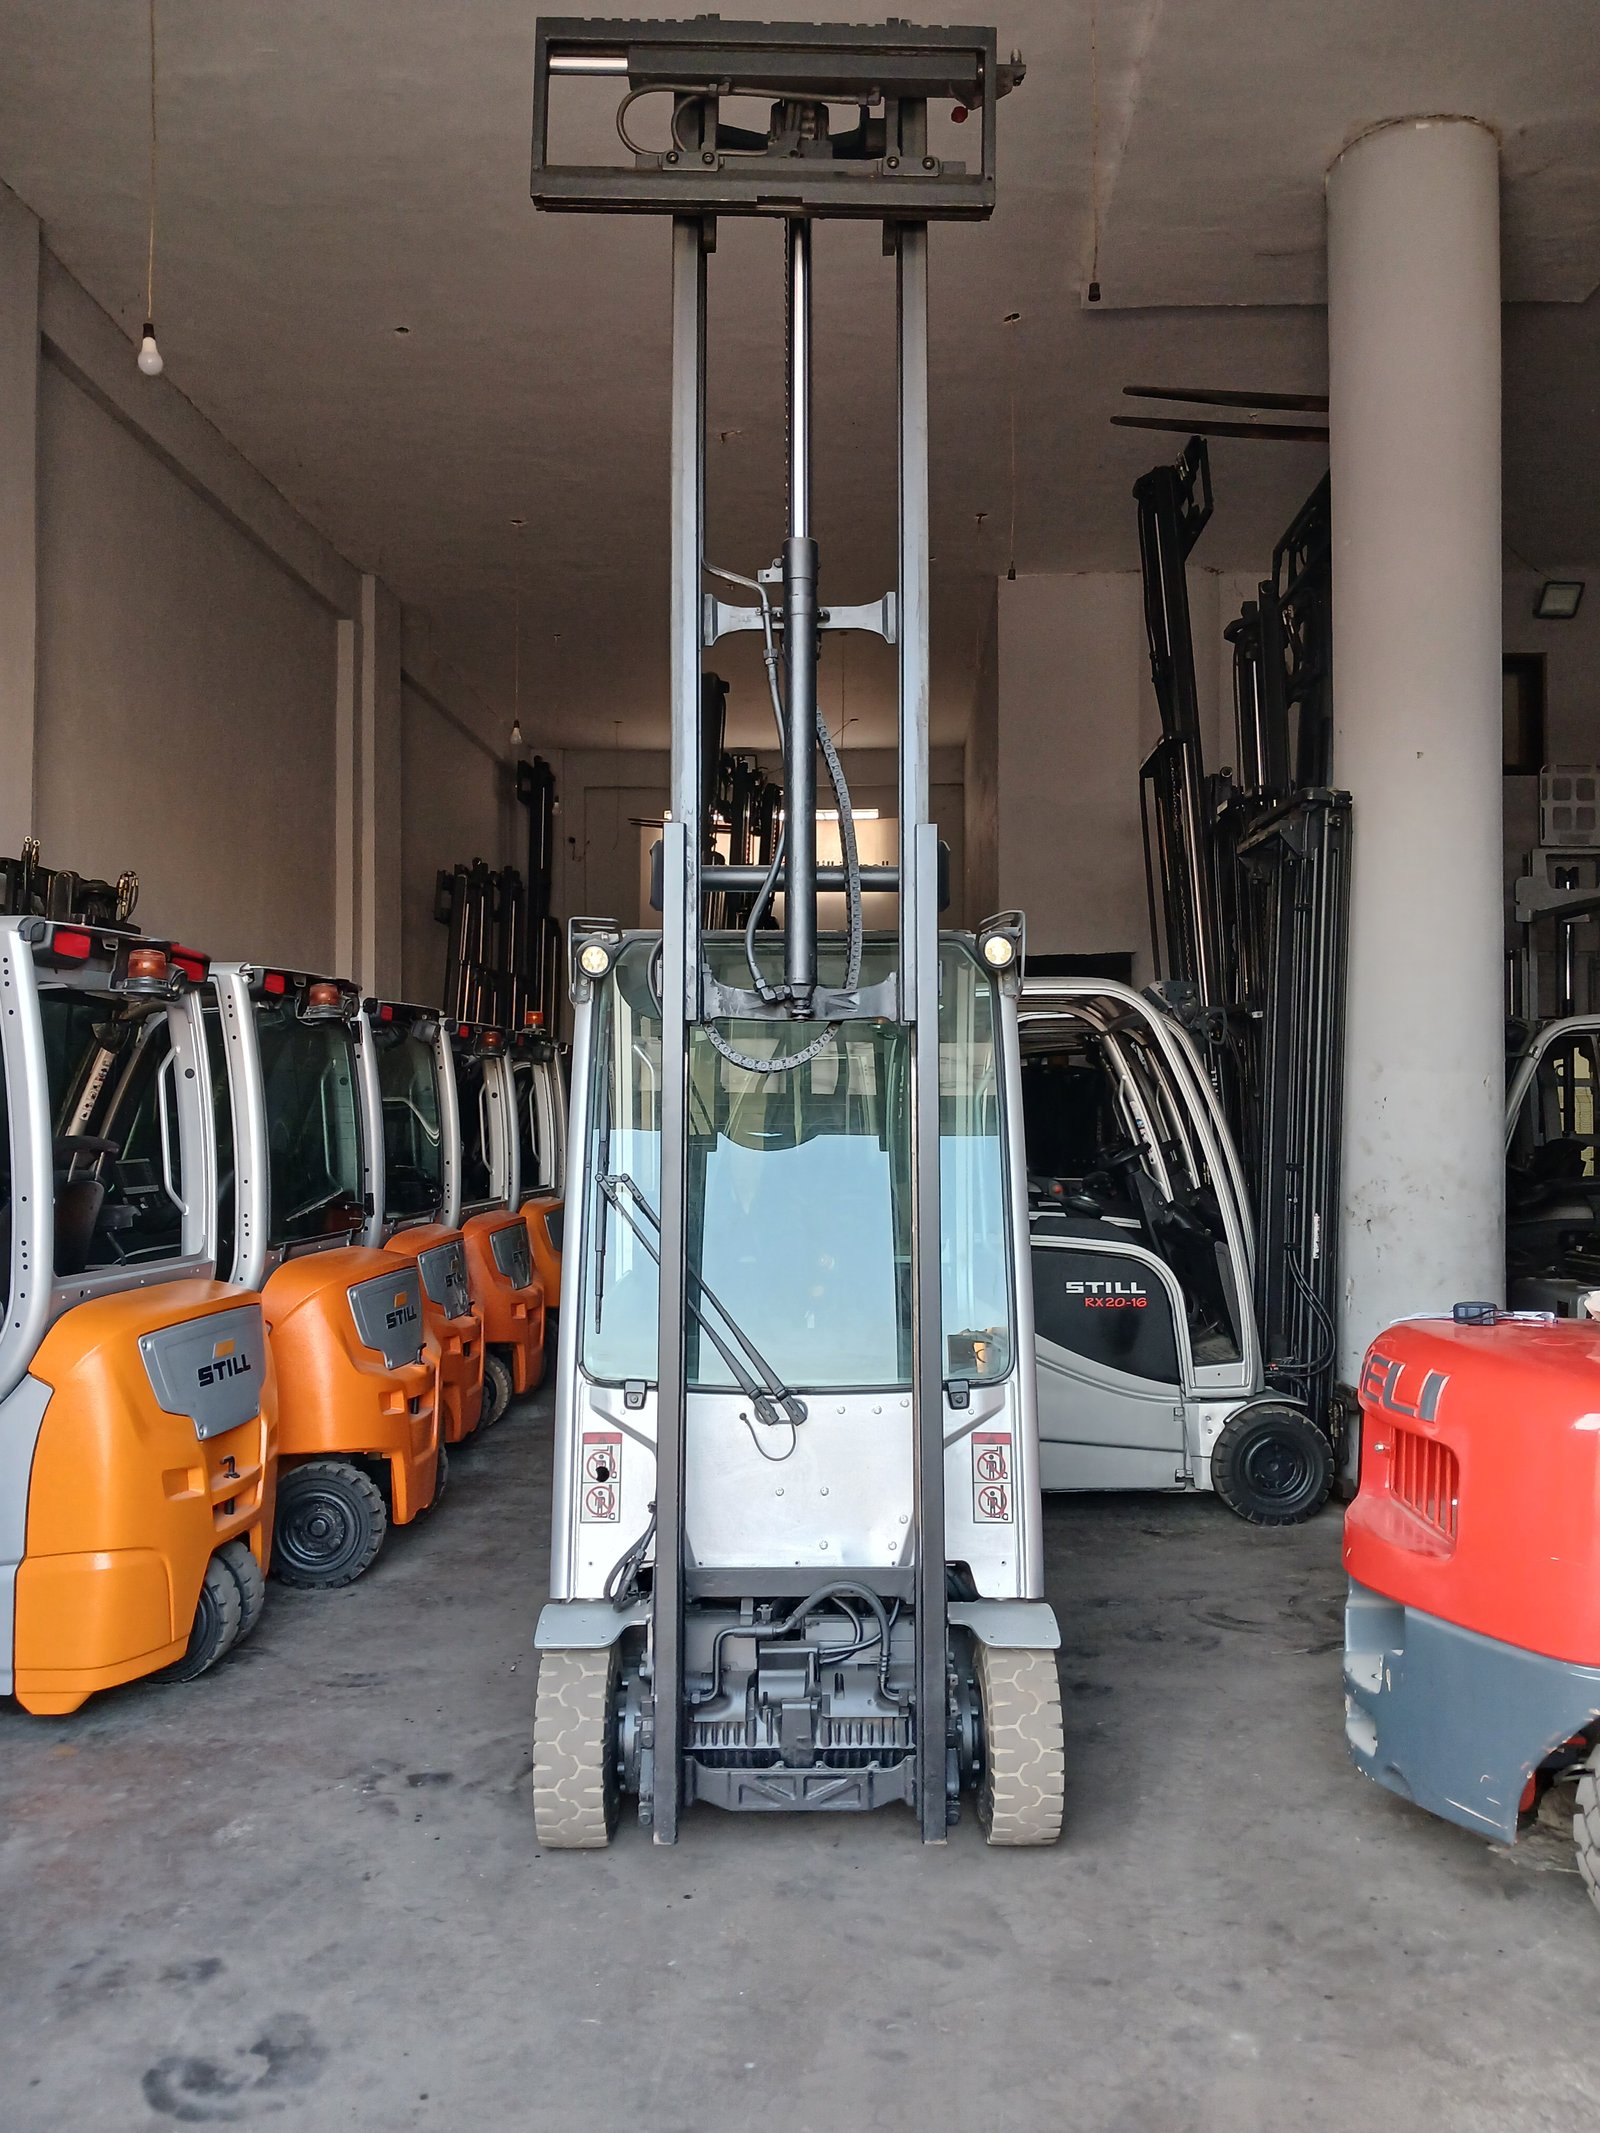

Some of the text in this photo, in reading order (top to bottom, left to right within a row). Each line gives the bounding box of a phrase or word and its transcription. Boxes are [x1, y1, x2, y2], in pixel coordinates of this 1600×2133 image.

[1066, 1282, 1146, 1293] STILL
[386, 1305, 417, 1329] STILL
[198, 1354, 251, 1387] STILL
[1362, 1345, 1451, 1424] ELI
